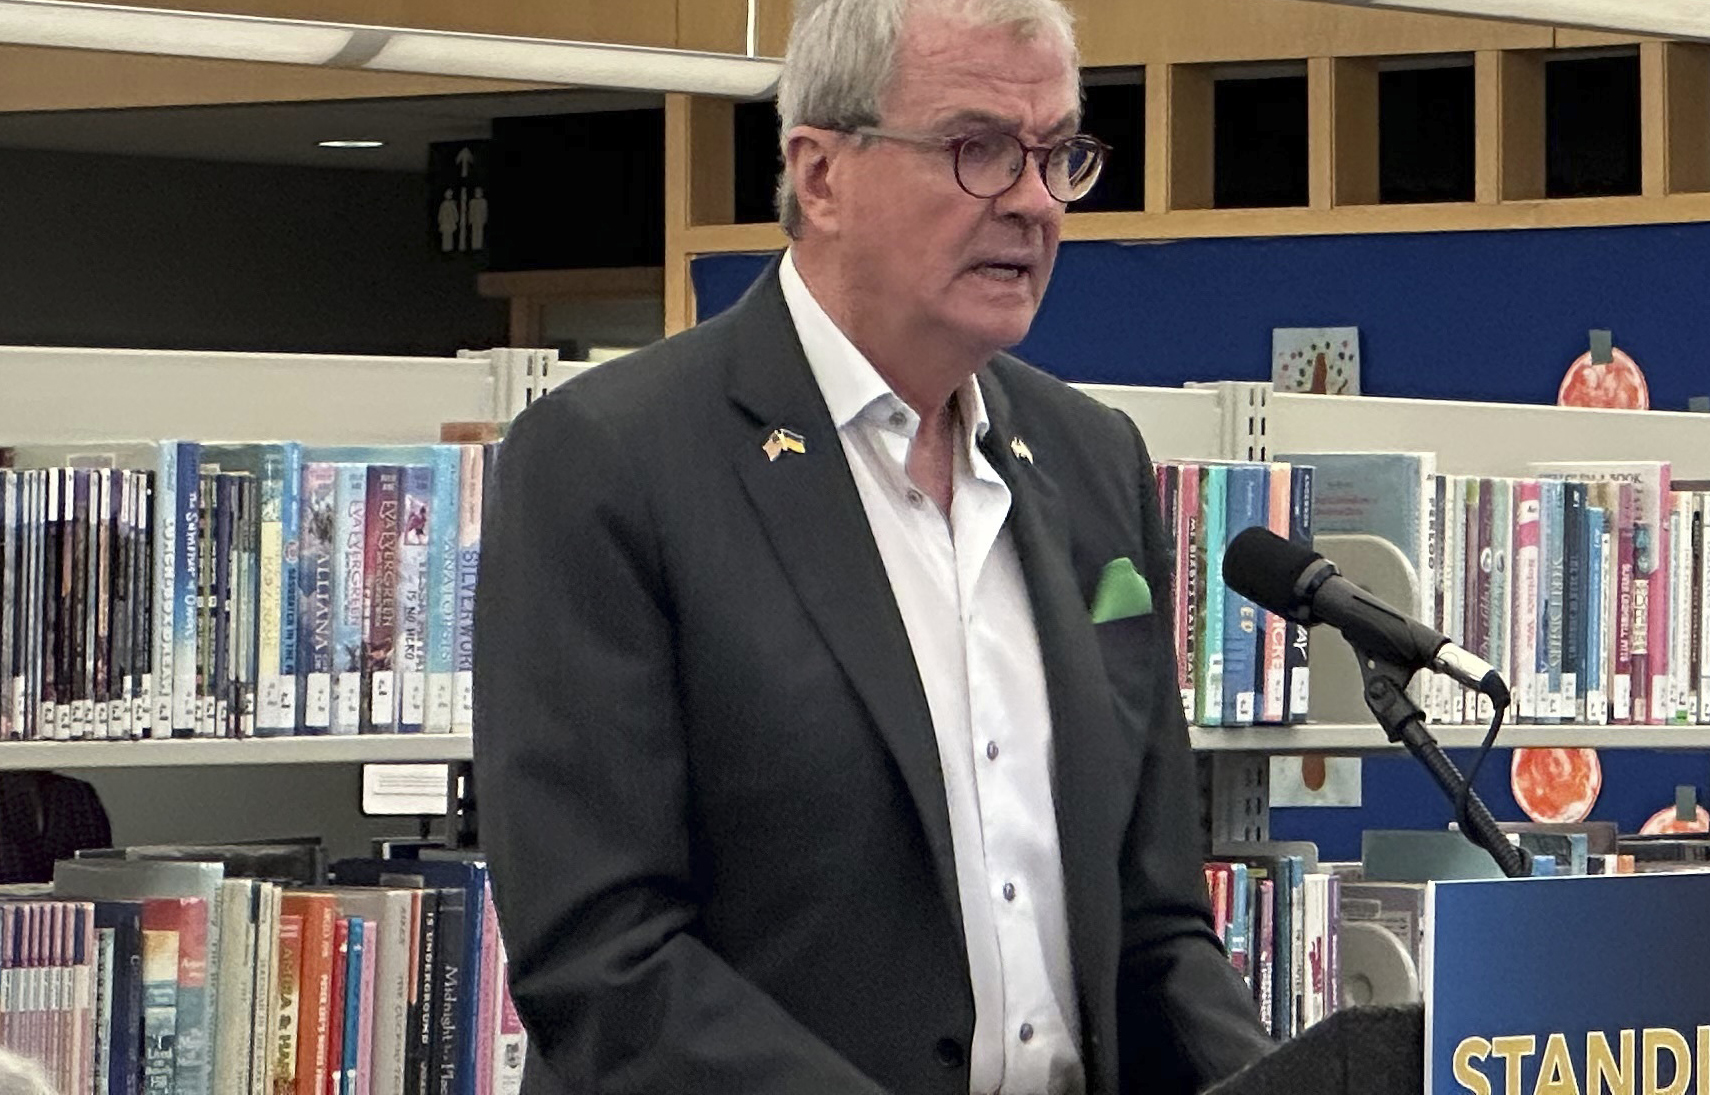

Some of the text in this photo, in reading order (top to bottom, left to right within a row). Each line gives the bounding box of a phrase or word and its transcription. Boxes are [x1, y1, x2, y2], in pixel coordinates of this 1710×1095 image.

[315, 553, 331, 651] ALLIANA
[405, 606, 416, 623] NO
[1550, 613, 1562, 668] SISTERS
[280, 946, 294, 1010] AMIRA
[421, 931, 433, 1045] UNDERGROUND
[440, 965, 459, 1042] Midnight
